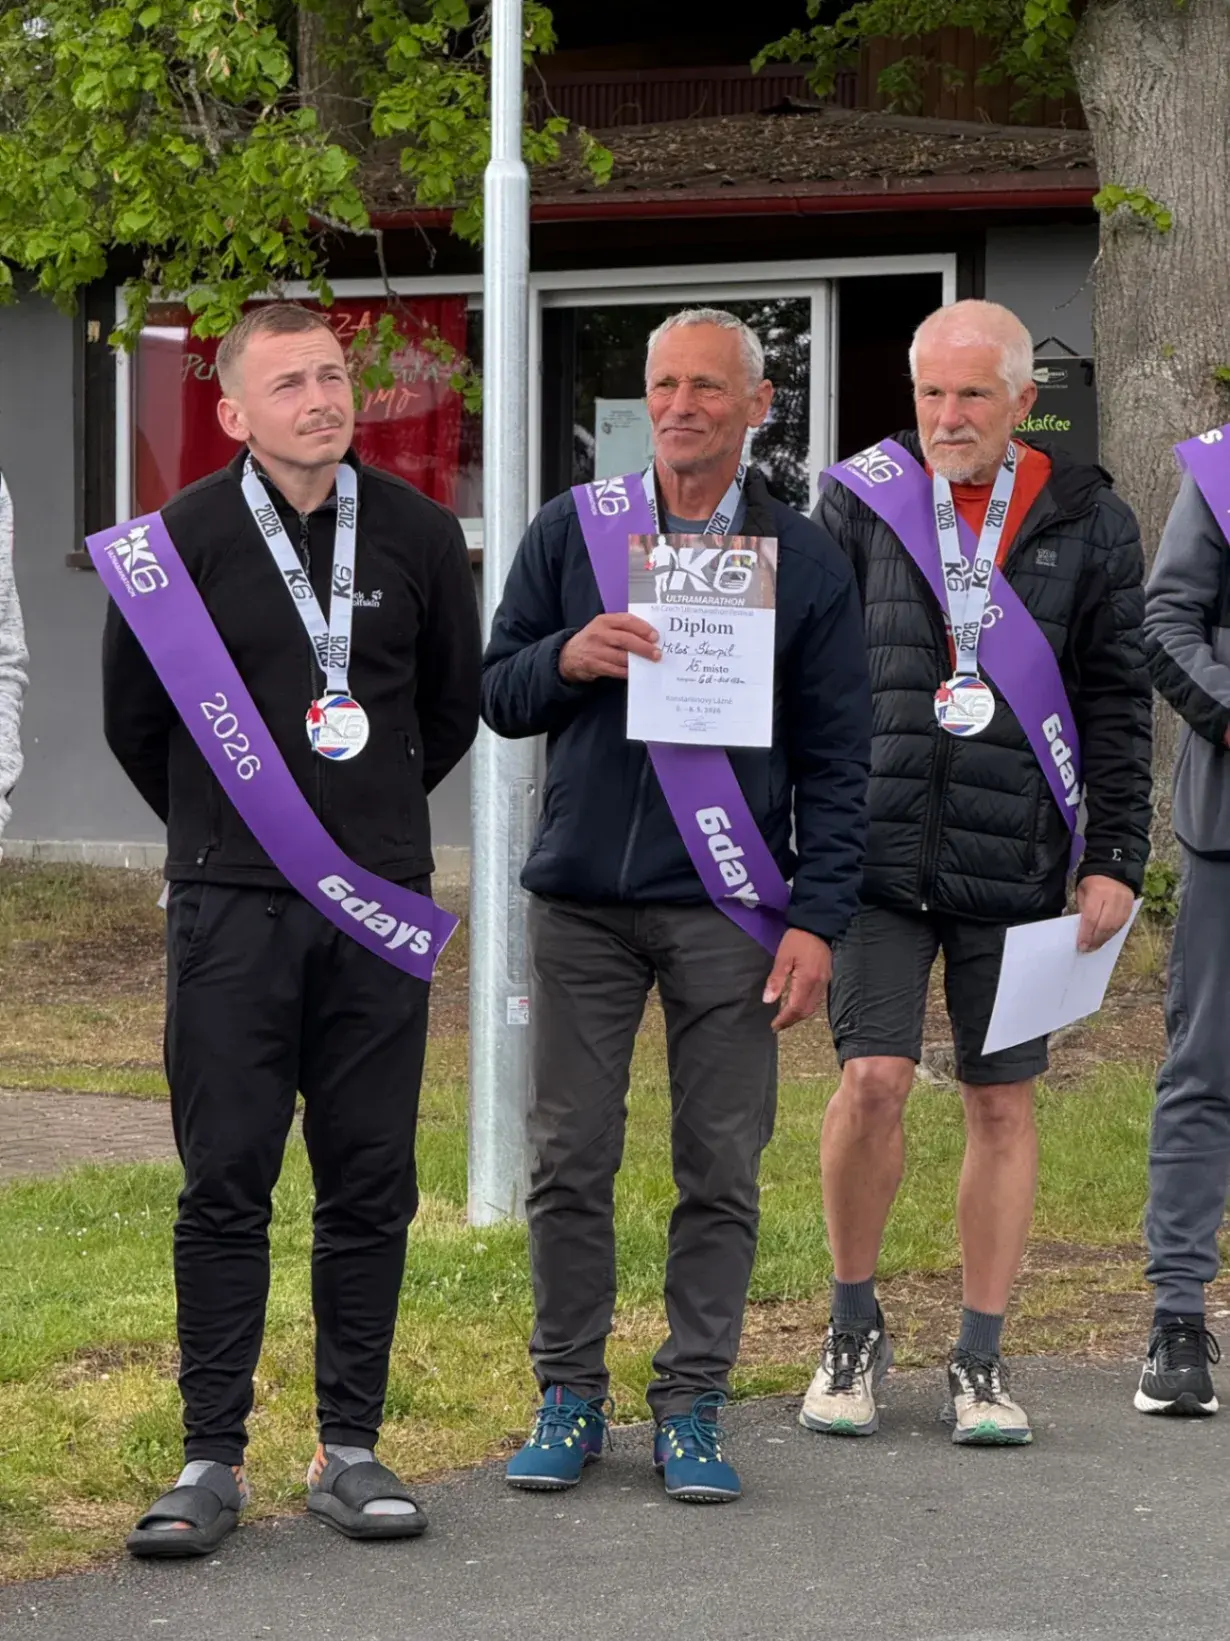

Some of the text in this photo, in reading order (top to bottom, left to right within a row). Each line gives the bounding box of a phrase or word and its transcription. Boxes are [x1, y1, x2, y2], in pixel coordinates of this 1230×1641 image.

[254, 504, 282, 538] 2026
[338, 496, 355, 530] 2026
[706, 511, 731, 536] 026
[936, 500, 955, 531] 2026
[985, 499, 1007, 528] 2026
[115, 537, 169, 594] K6
[332, 563, 352, 600] K6
[668, 547, 758, 594] K6
[944, 562, 965, 592] K6
[971, 557, 992, 590] K6
[283, 568, 314, 600] K6
[666, 594, 745, 606] ULTRAMARATHON
[668, 617, 734, 638] Diplom
[960, 621, 979, 651] 2026
[329, 635, 348, 669] 2026
[200, 692, 261, 780] 2026
[1042, 713, 1081, 807] 6day
[695, 806, 760, 908] 6day
[317, 874, 432, 955] 6days
